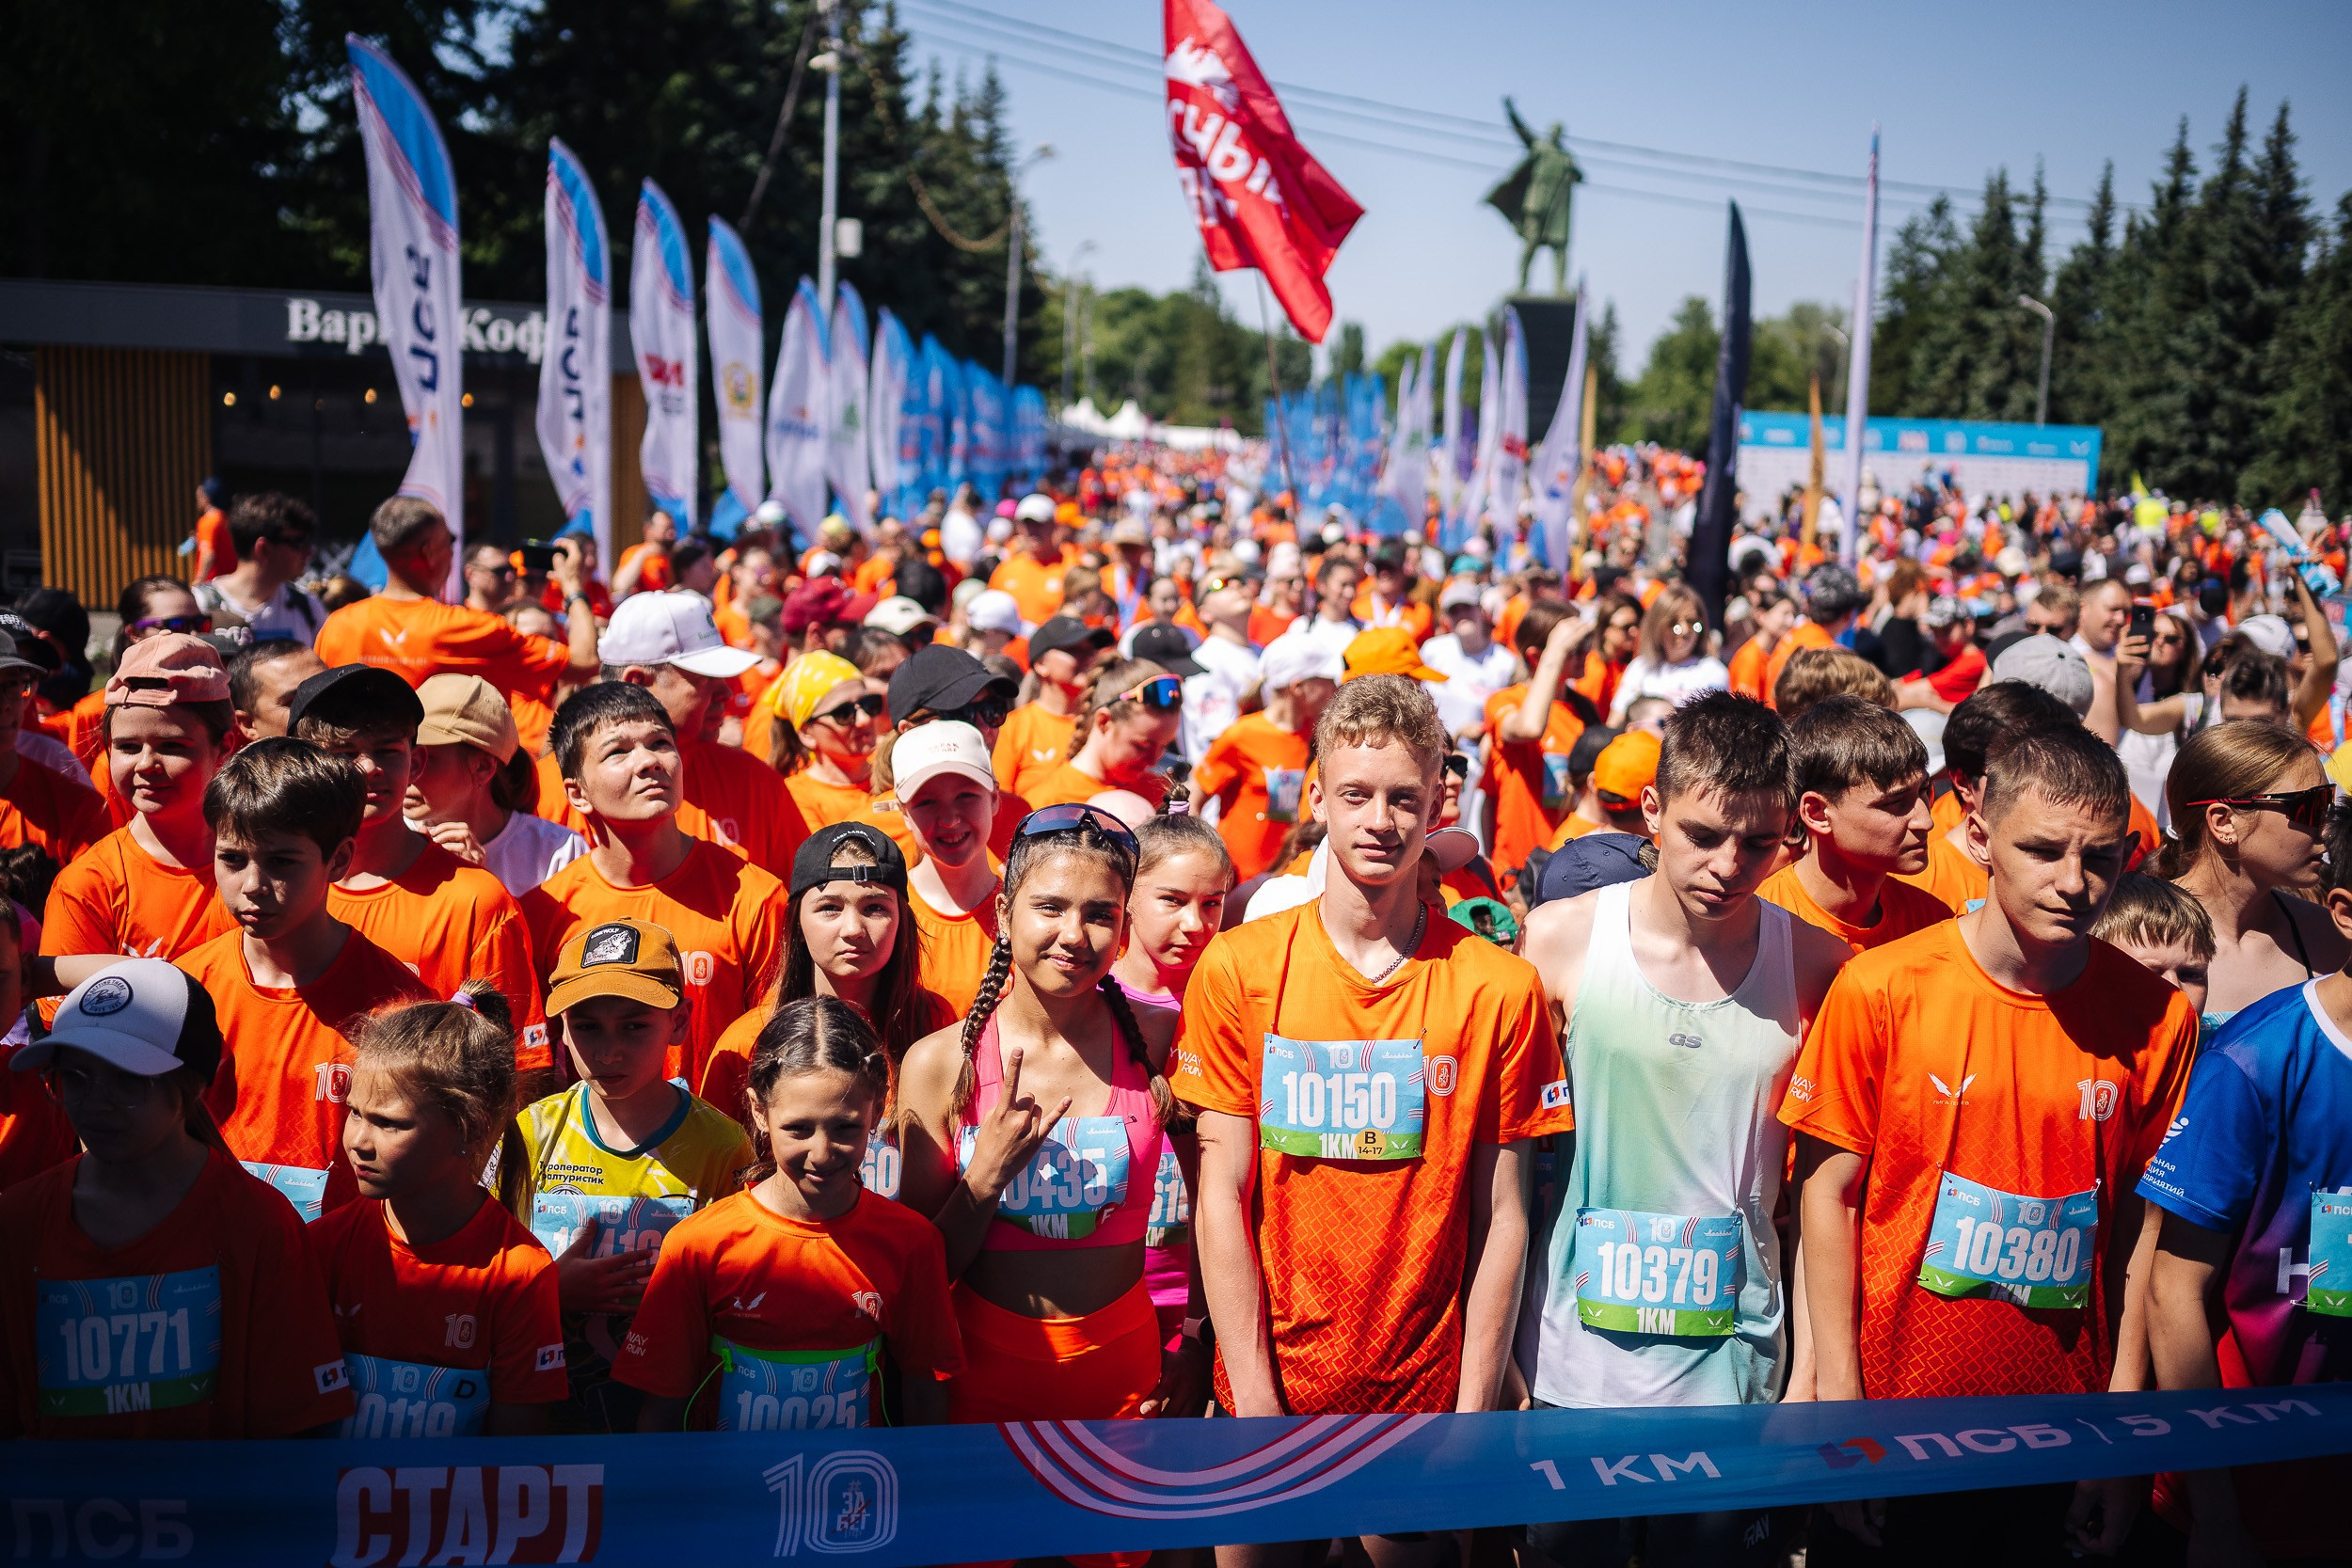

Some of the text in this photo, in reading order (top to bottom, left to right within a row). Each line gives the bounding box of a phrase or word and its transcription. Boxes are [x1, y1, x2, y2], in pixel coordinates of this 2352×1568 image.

[459, 309, 548, 363] Коф
[1276, 1048, 1295, 1060] ПСБ
[1669, 1033, 1703, 1049] GS
[1181, 1062, 1203, 1078] RUN
[1282, 1071, 1397, 1130] 10150
[1788, 1085, 1813, 1102] RUN
[2076, 1078, 2119, 1122] 10
[1358, 1146, 1383, 1155] 14-17
[539, 1171, 605, 1185] ралтуристик
[997, 1148, 1108, 1211] 0435
[548, 1204, 567, 1215] ПСБ
[1957, 1192, 1981, 1208] ПСБ
[2333, 1205, 2352, 1215] ПС
[1593, 1217, 1615, 1230] ПСБ
[1954, 1214, 2082, 1283] 10380
[1597, 1242, 1720, 1306] 10379
[60, 1307, 192, 1382] 10771
[626, 1343, 646, 1356] RUN
[739, 1365, 756, 1380] ПСБ
[453, 1379, 477, 1400] D
[341, 1391, 458, 1438] 0119
[737, 1389, 857, 1432] 10025
[1895, 1423, 2073, 1461] ПСБ
[2114, 1414, 2171, 1437] 5
[1530, 1460, 1566, 1491] 1
[329, 1464, 605, 1568] СТАРТ
[762, 1449, 898, 1558] 10
[9, 1497, 195, 1560] ПСБ
